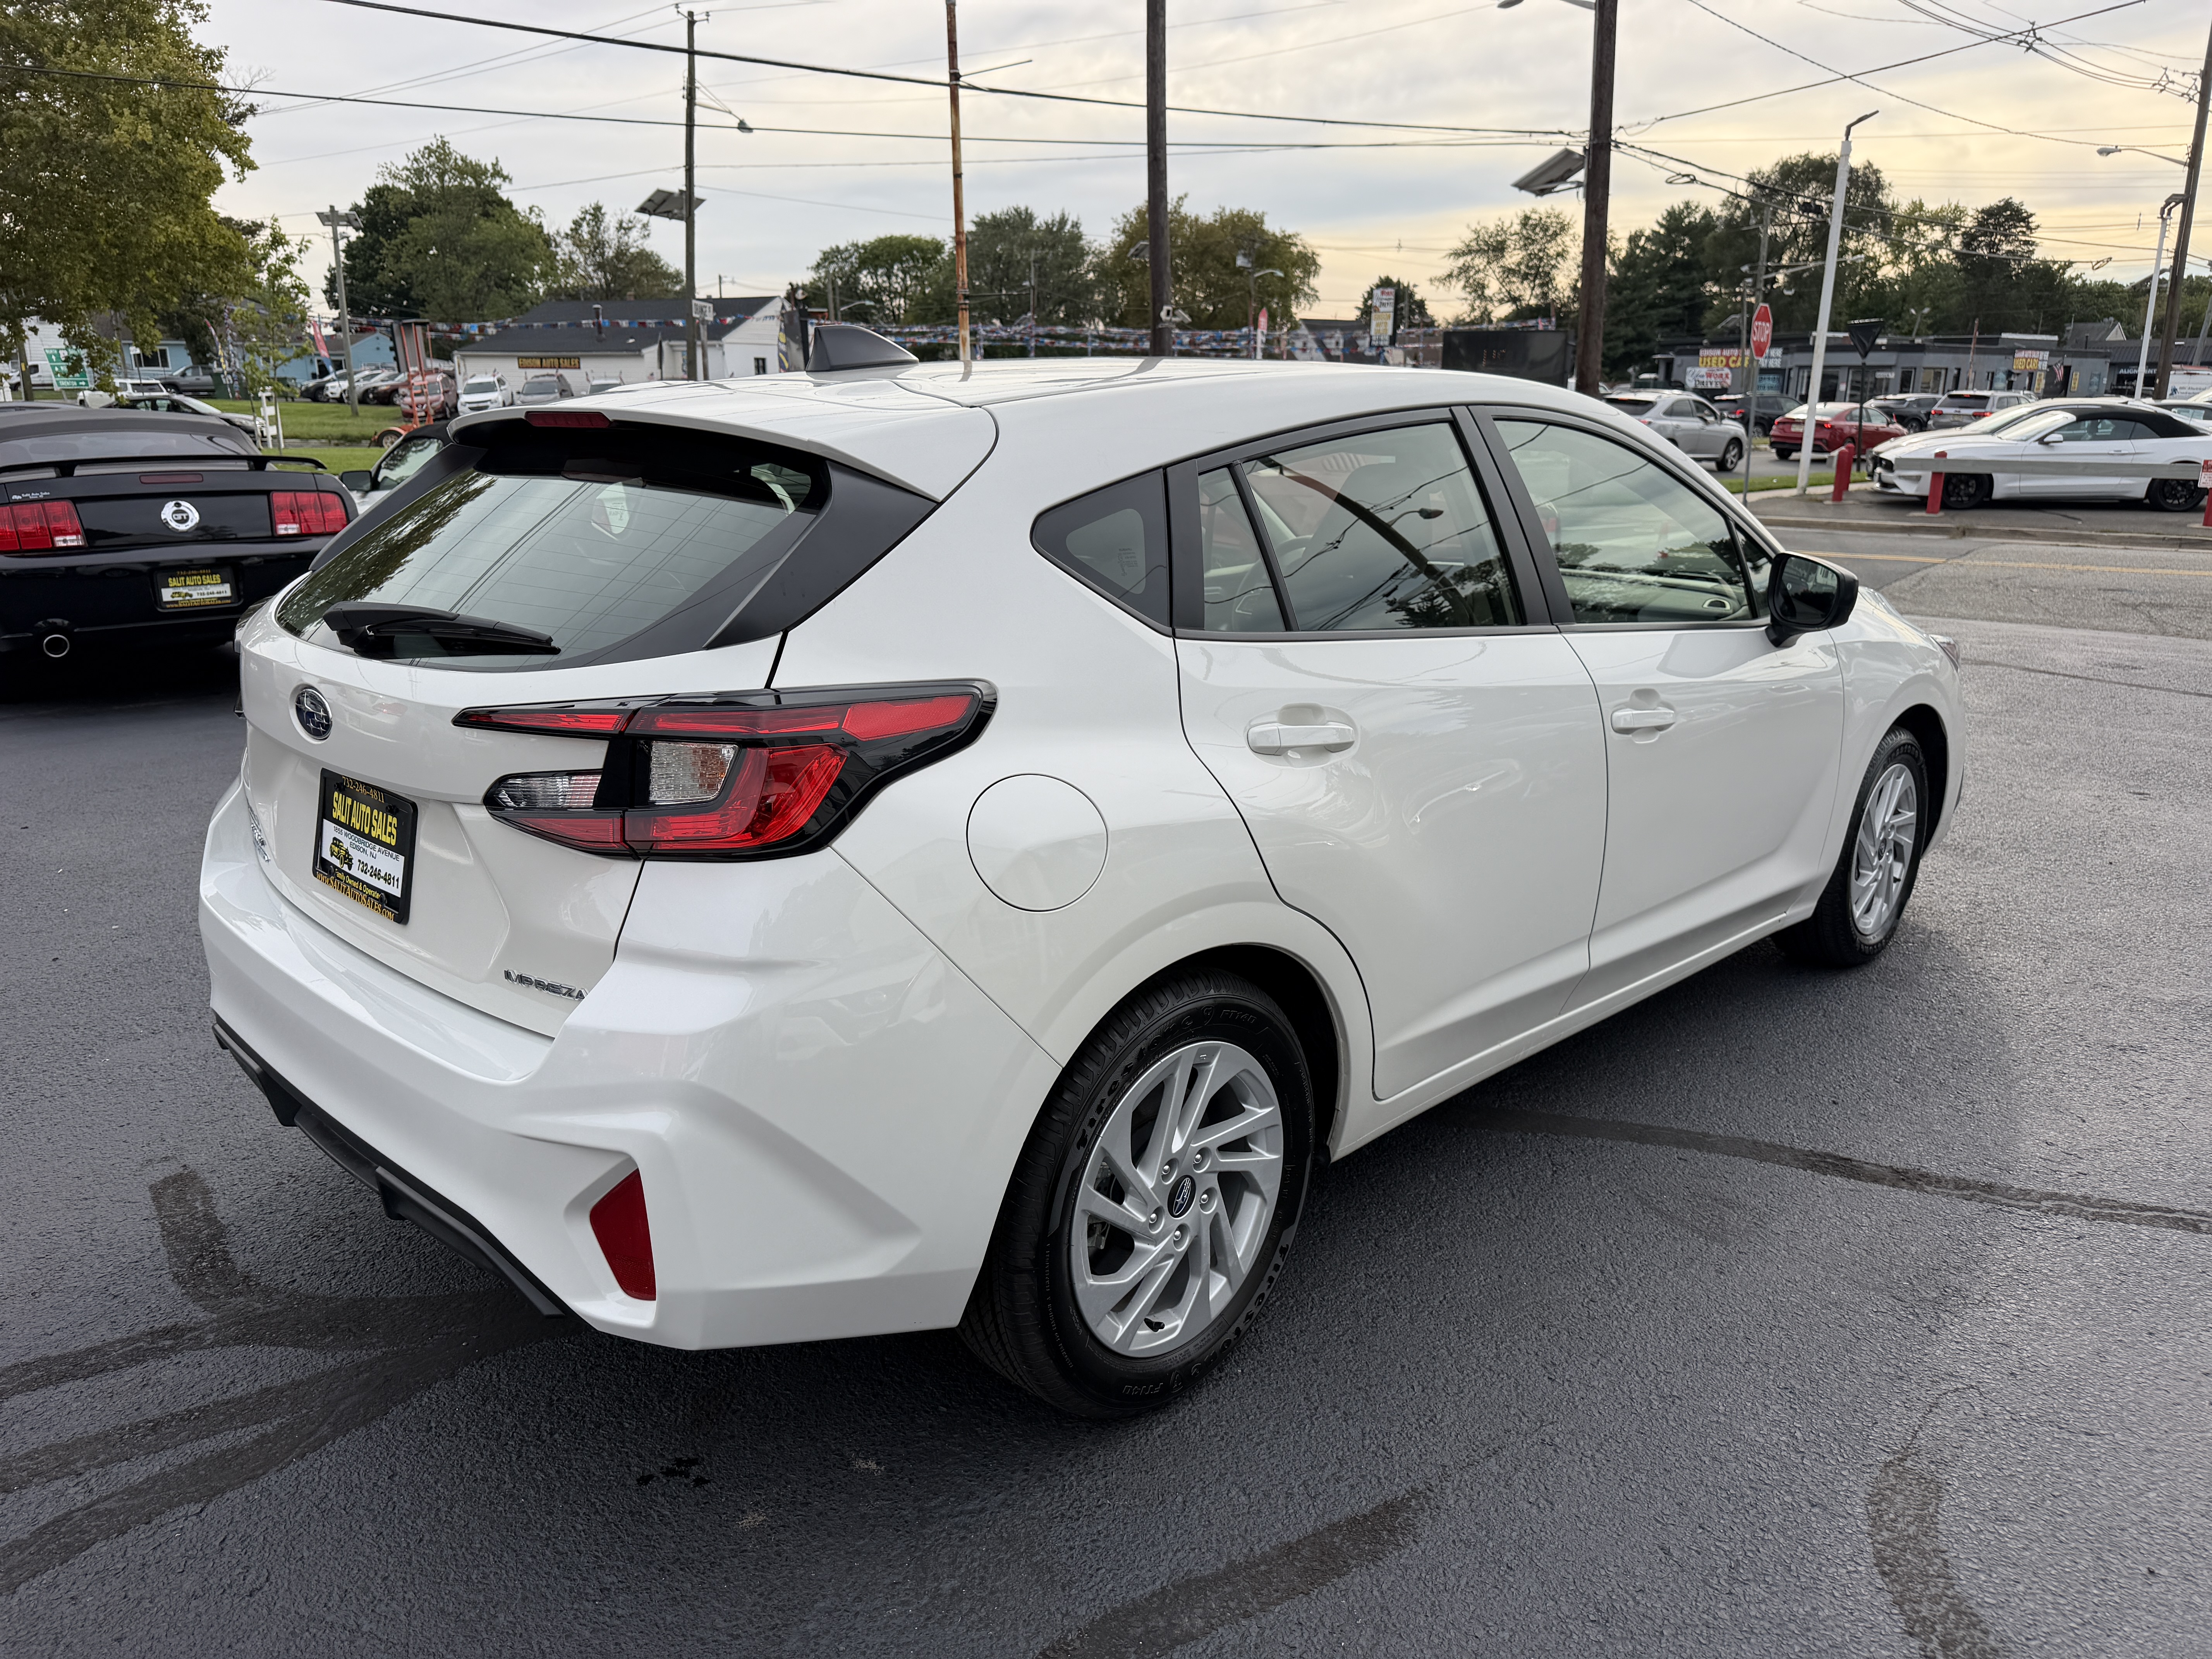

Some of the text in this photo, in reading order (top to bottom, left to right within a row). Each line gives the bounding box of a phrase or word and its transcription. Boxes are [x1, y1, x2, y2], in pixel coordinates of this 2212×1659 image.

[1753, 321, 1770, 343] STOP
[519, 358, 579, 368] EDISON AUTO SALES
[1698, 356, 1726, 368] USED
[2013, 358, 2026, 370] USED
[2026, 358, 2039, 370] CARS
[168, 574, 221, 587] SALIT AUTO SALES
[342, 776, 385, 803] 732-246-4811
[332, 791, 397, 846] SALIT AUTO SALES
[333, 826, 400, 862] 1855 WOODBRIDGE AVENUE
[350, 842, 377, 859] EDISON, NJ
[345, 875, 359, 889] Owned
[359, 881, 362, 891] &
[357, 859, 399, 889] 732-246-4811
[504, 969, 589, 1001] IMPREZA
